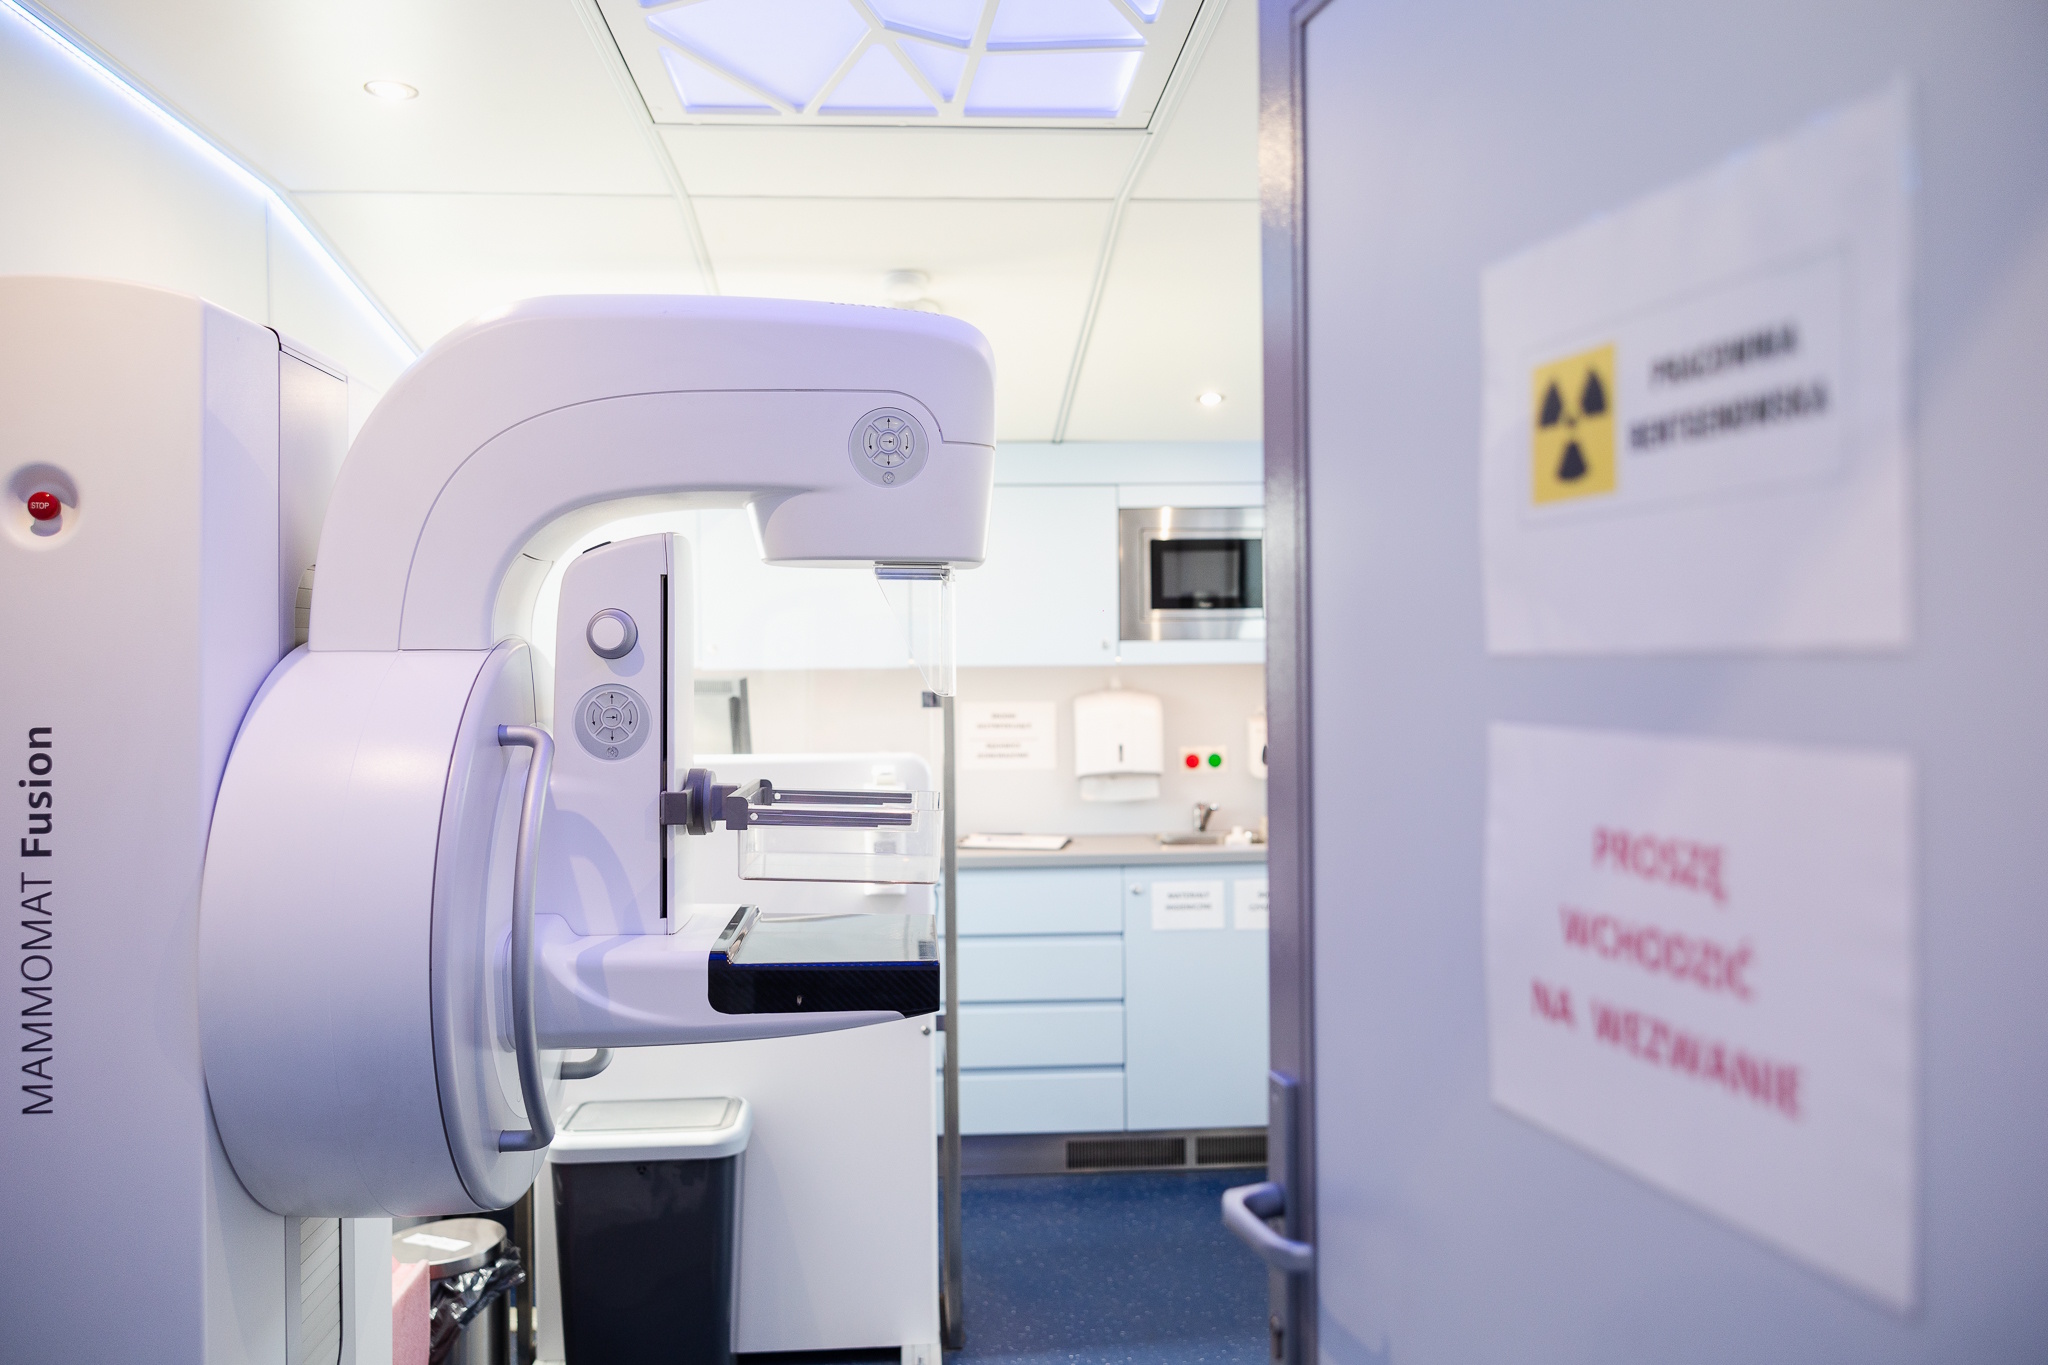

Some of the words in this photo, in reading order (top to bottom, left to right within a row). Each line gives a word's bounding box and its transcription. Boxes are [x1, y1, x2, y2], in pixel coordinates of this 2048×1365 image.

[18, 726, 53, 858] Fusion
[1593, 825, 1727, 906] PROSZĘ
[21, 872, 53, 1115] MAMMOMAT
[1559, 905, 1755, 1001] WCHODZIĆ
[1531, 977, 1575, 1028] NA
[1590, 999, 1803, 1122] WEZWANIE
